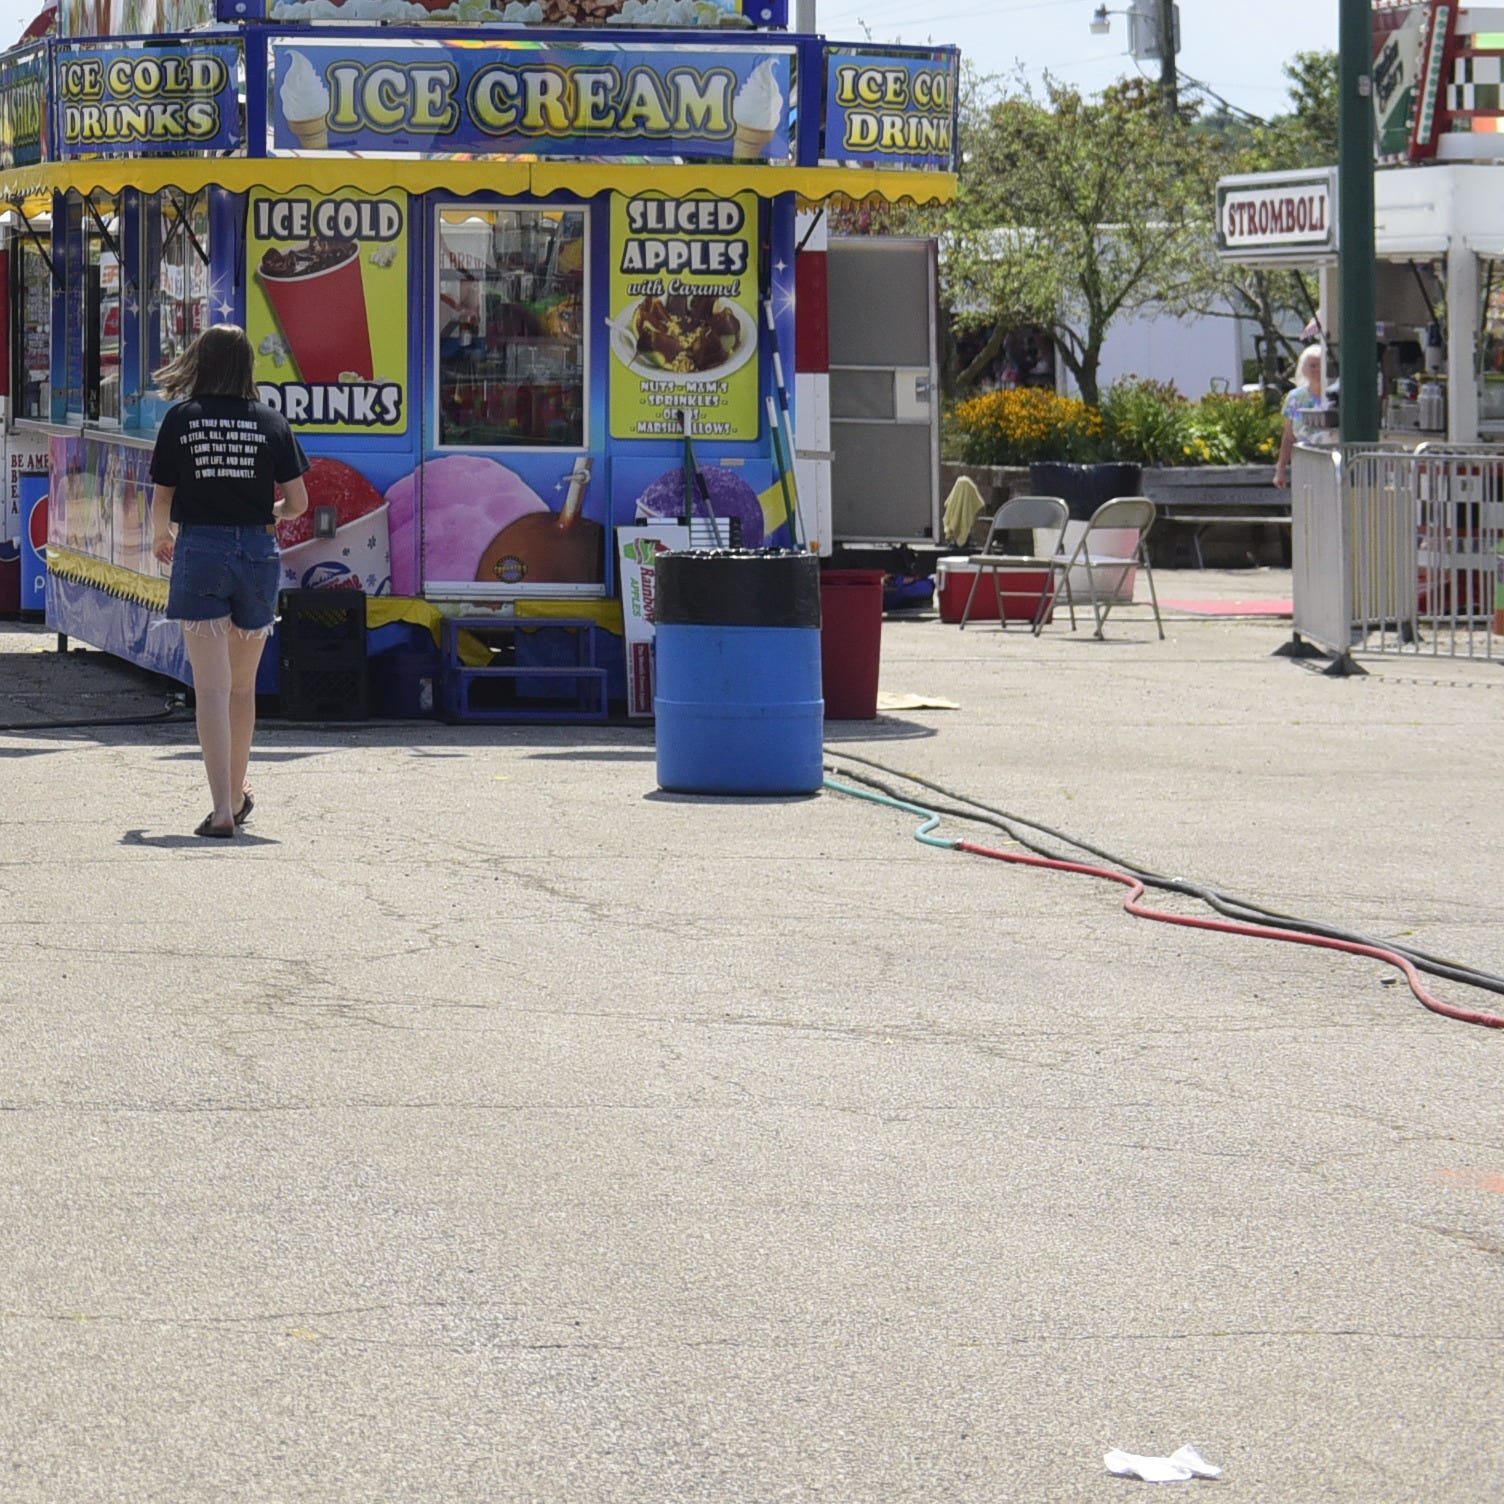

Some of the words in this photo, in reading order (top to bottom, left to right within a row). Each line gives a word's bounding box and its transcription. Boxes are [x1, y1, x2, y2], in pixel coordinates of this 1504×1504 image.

[60, 59, 103, 99] ICE
[109, 56, 226, 96] COLD
[837, 65, 909, 109] ICE
[327, 61, 457, 134] ICE
[467, 62, 738, 139] CREAM
[65, 99, 219, 142] DRINKS
[254, 197, 310, 241] ICE
[314, 197, 404, 240] COLD
[627, 198, 745, 235] SLICED
[1228, 195, 1326, 237] STROMBOLI
[621, 238, 748, 275] APPLES
[627, 278, 664, 296] with
[667, 278, 740, 298] Caramel
[260, 382, 402, 427] DRINKS
[640, 380, 675, 393] NUTS
[685, 380, 729, 394] M&M'S
[648, 394, 721, 407] SPRINKLES
[180, 434, 188, 445] TO
[188, 431, 208, 443] STEAL,
[209, 431, 224, 441] KILL,
[226, 431, 239, 440] AND
[239, 431, 268, 444] DESTROY.
[189, 419, 199, 429] THE
[201, 419, 217, 429] THIEF
[219, 419, 235, 428] ONLY
[237, 419, 258, 430] COMES
[11, 454, 25, 468] BE
[194, 444, 210, 453] CAME
[212, 444, 227, 453] THAT
[228, 444, 243, 453] THEY
[244, 445, 258, 454] MAY
[195, 457, 209, 466] HAVE
[210, 456, 224, 466] LIFE,
[226, 456, 238, 465] AND
[240, 457, 255, 466] HAVE
[195, 470, 201, 479] IT
[202, 468, 216, 478] MORE
[217, 468, 257, 479] ABUNDANTLY.
[630, 577, 642, 617] APPLES
